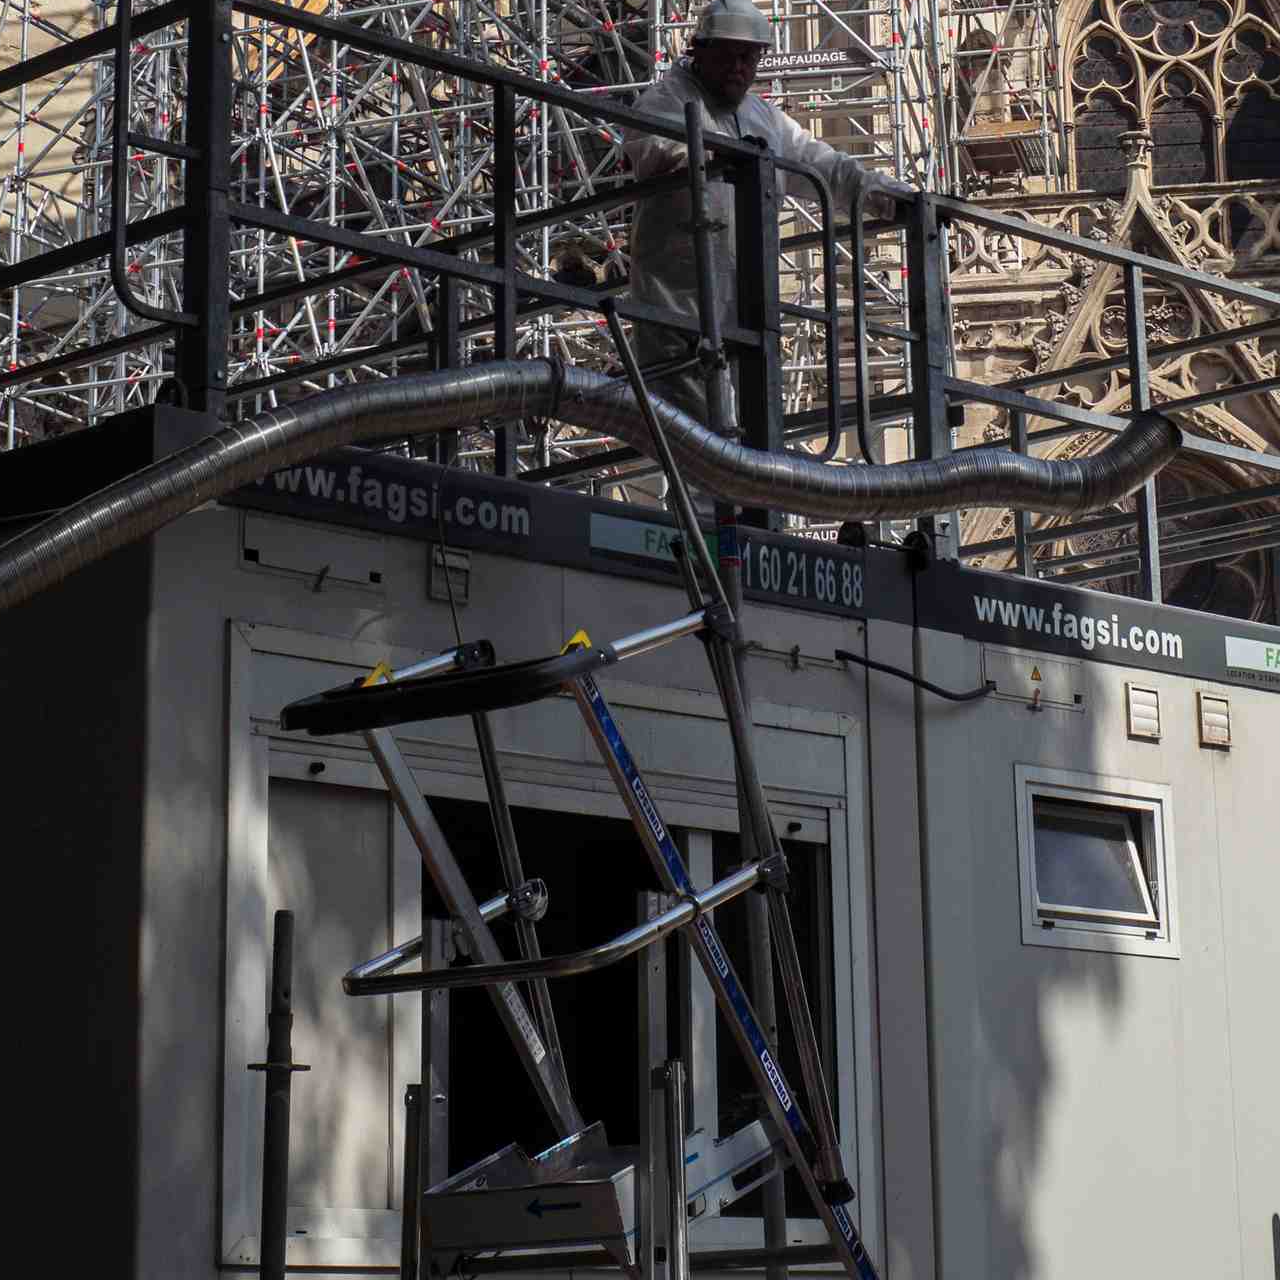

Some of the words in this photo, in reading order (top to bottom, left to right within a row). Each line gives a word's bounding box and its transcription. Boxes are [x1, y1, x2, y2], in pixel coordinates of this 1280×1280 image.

[256, 465, 529, 537] ww.fagsi.com
[759, 545, 781, 592] 60
[787, 551, 807, 598] 21
[814, 556, 836, 602] 66
[842, 562, 864, 608] 88
[974, 595, 1184, 659] www.fagsi.com
[762, 1052, 791, 1107] TUBESCA
